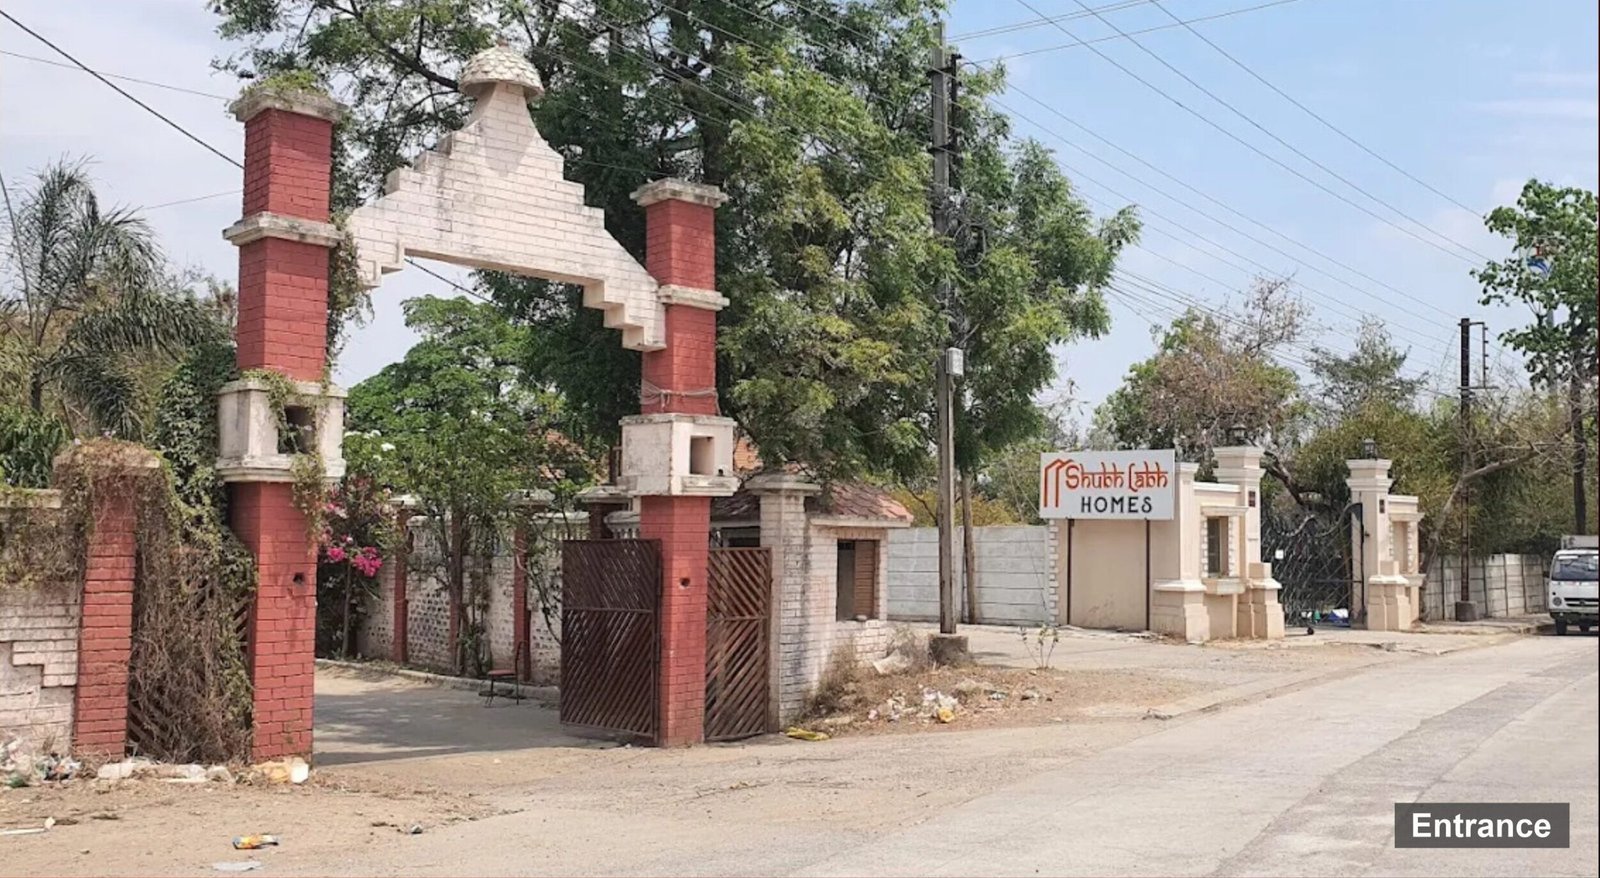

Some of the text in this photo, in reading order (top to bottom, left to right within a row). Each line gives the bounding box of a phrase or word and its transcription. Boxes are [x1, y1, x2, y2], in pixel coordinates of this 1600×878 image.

[1065, 461, 1169, 492] Shubh Labh
[1080, 496, 1153, 513] HOMES
